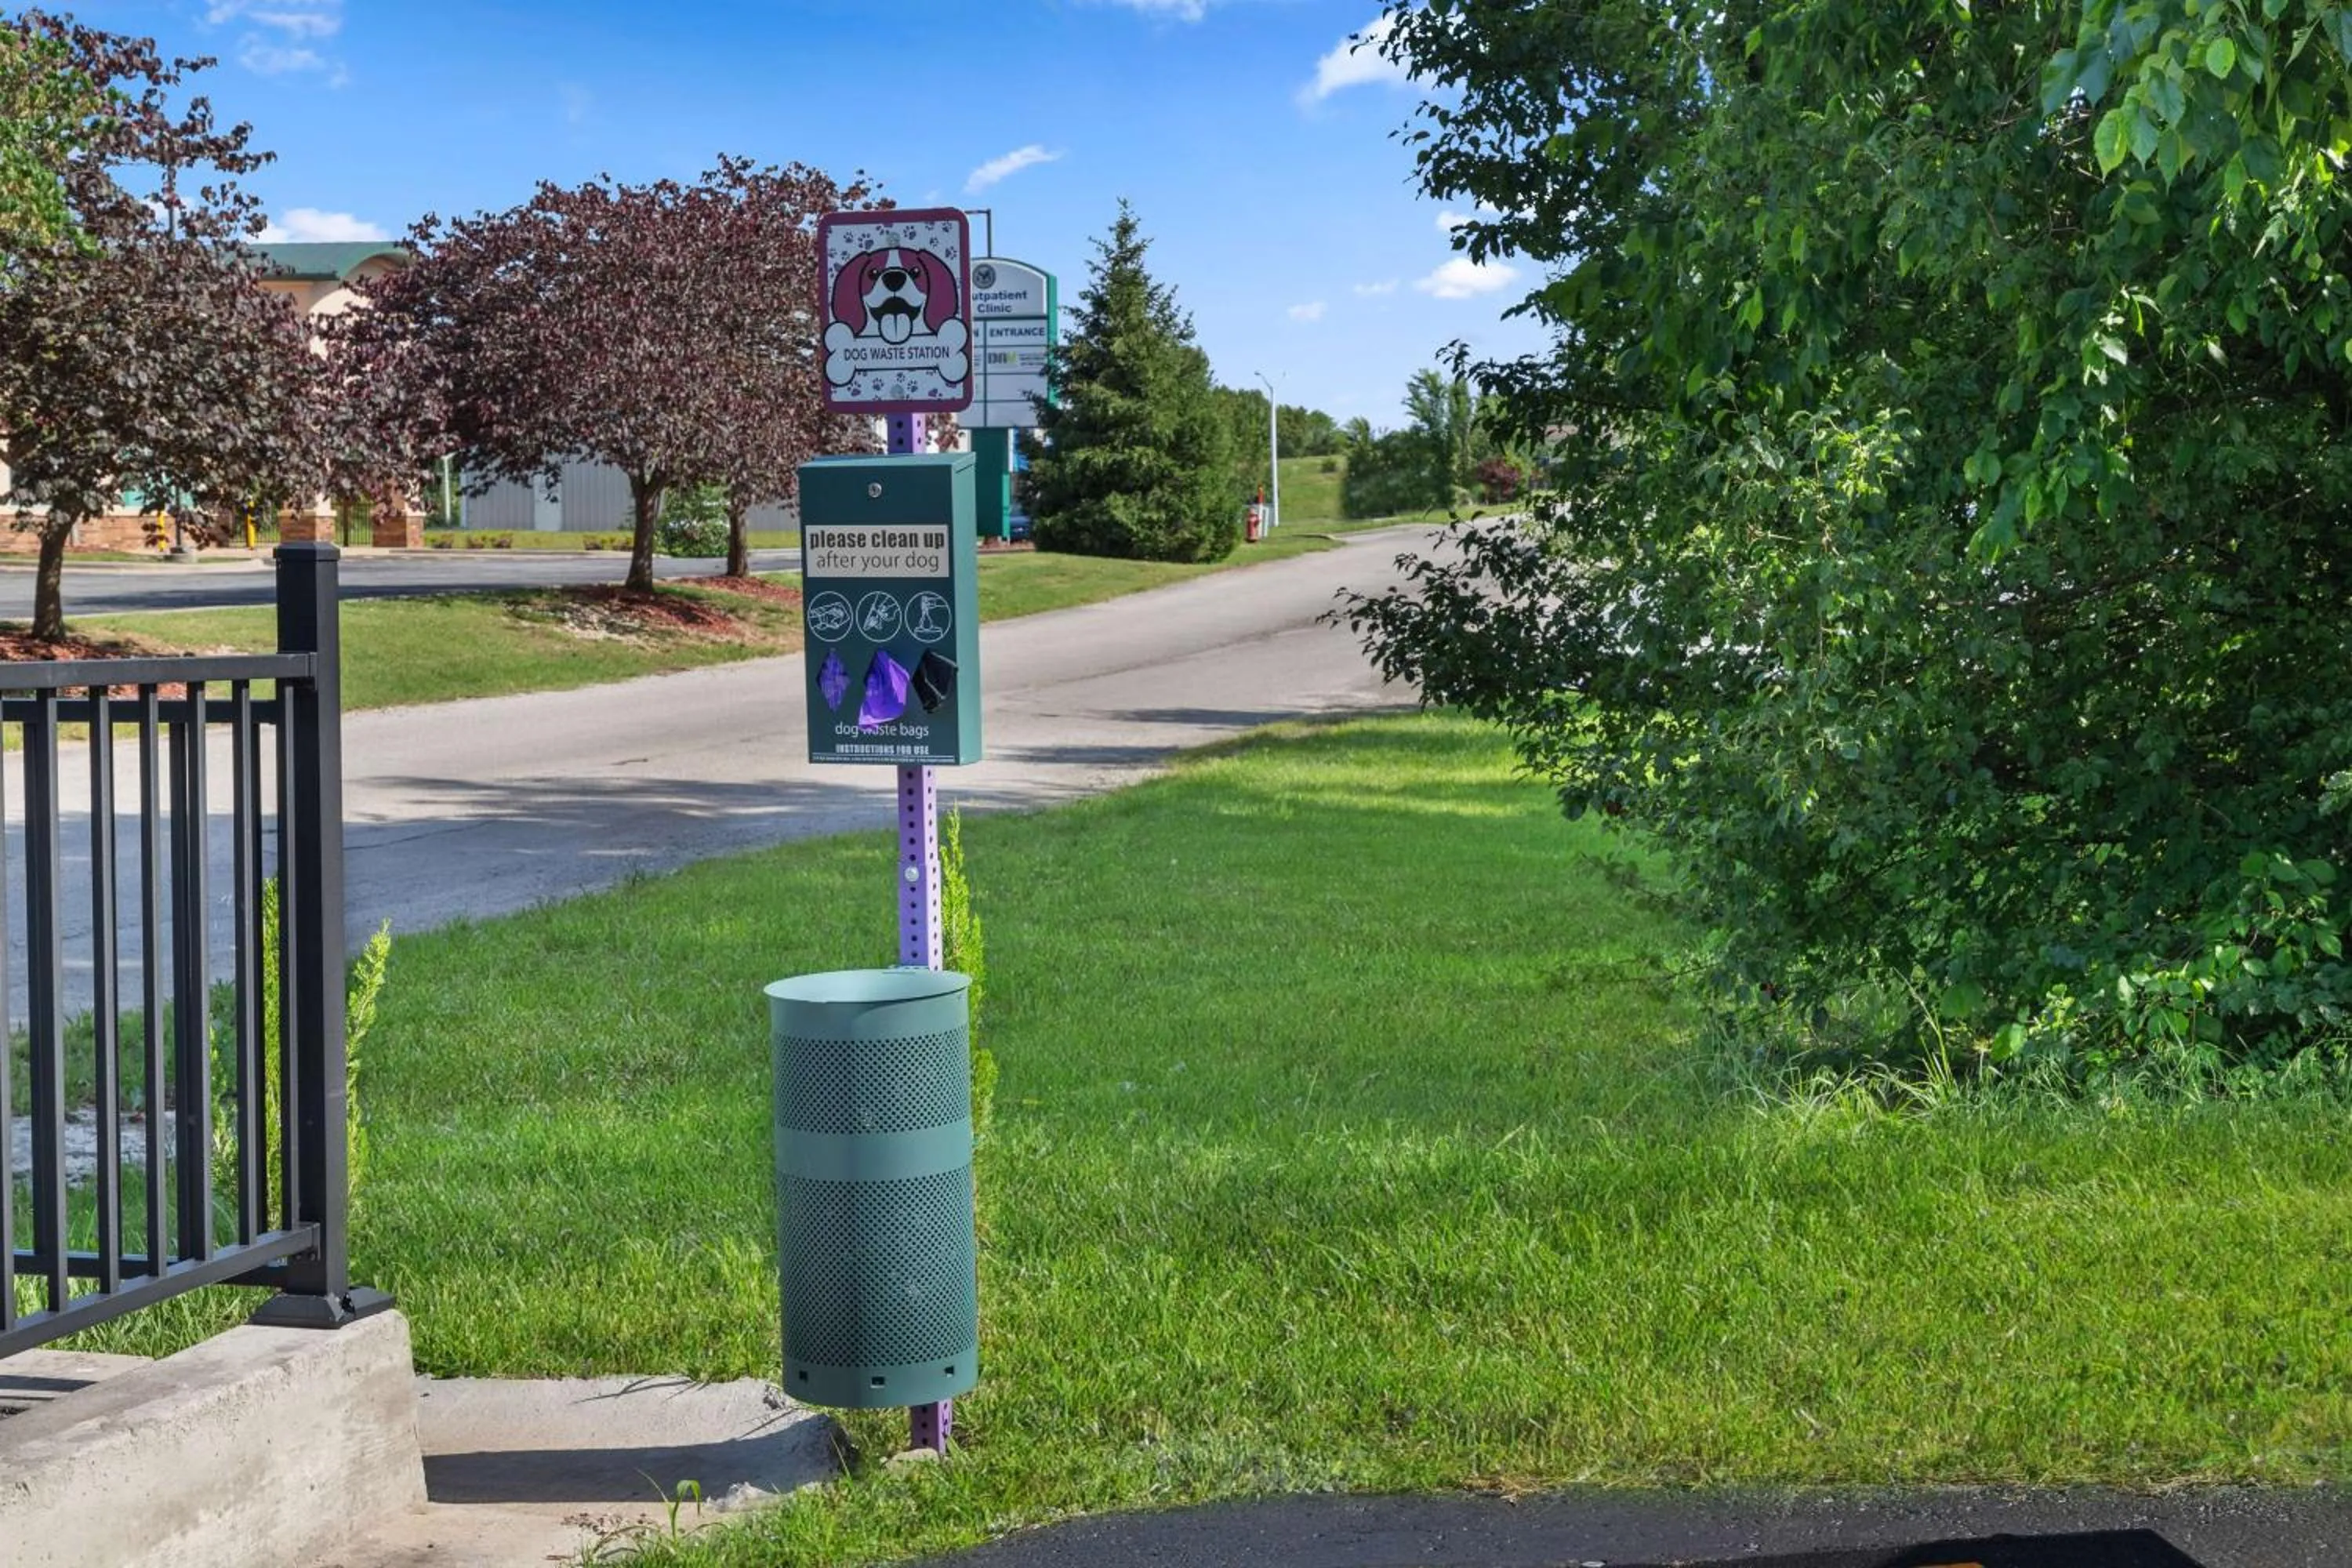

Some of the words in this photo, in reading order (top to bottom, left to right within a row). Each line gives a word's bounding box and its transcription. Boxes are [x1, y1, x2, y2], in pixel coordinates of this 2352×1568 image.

[972, 290, 1027, 303] utpatient
[978, 303, 1012, 313] Clinic
[989, 327, 1045, 337] ENTRANCE
[844, 348, 868, 361] DOG
[869, 347, 904, 360] WASTE
[907, 346, 949, 359] STATION
[810, 529, 866, 550] please
[871, 529, 919, 548] clean
[924, 532, 945, 550] up
[816, 550, 856, 569] after
[858, 554, 900, 572] your
[905, 551, 940, 572] dog
[835, 721, 858, 738] dog
[899, 723, 929, 739] bags
[835, 744, 895, 755] INSTRUCTIONS
[896, 745, 912, 755] FOR
[913, 746, 929, 755] USE
